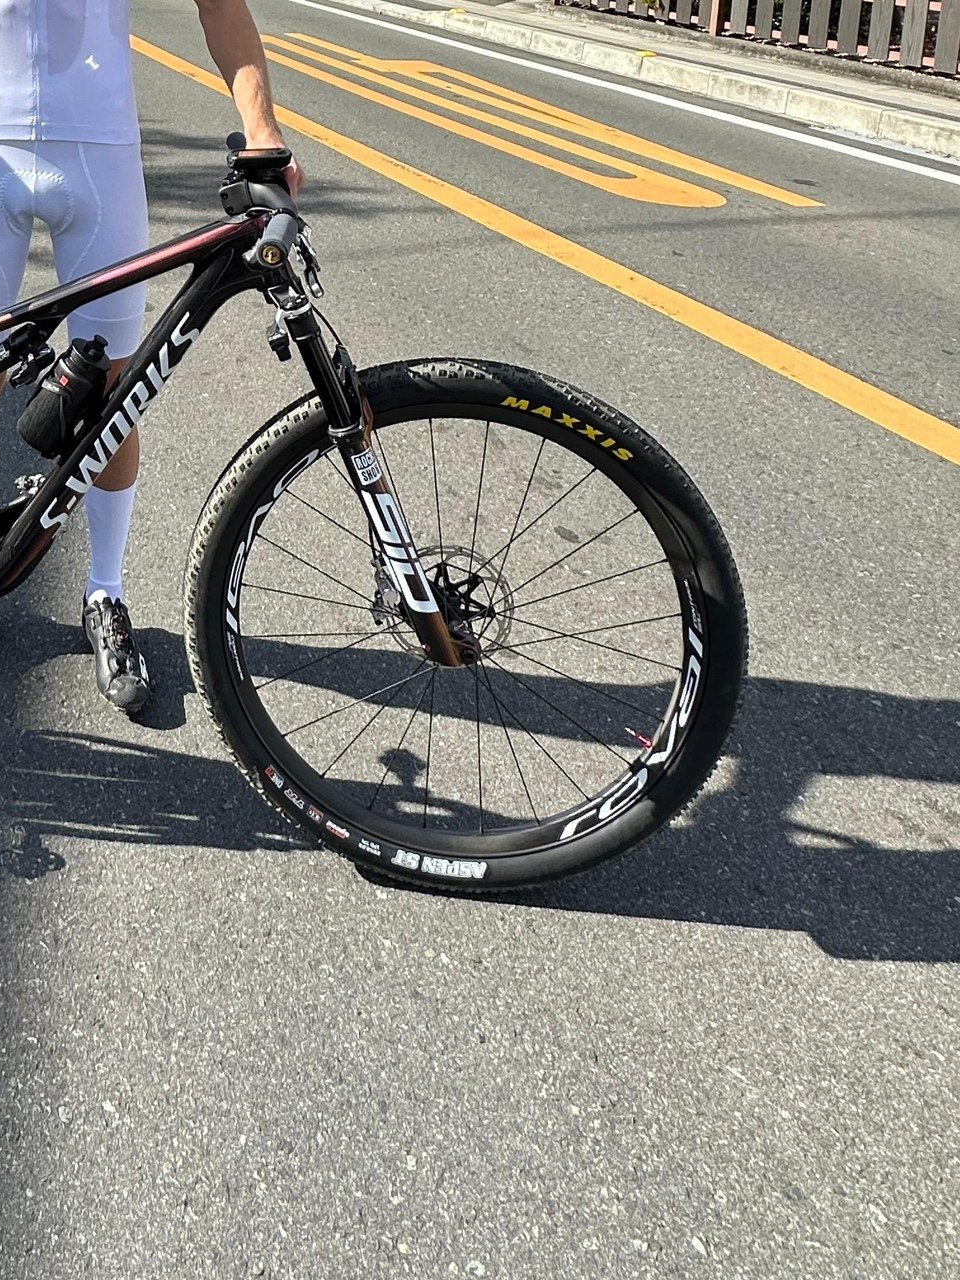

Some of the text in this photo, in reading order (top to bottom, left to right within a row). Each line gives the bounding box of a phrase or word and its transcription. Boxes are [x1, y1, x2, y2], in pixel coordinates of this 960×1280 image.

[40, 311, 200, 529] S-WORKS
[500, 396, 634, 461] MAXXIS
[360, 489, 440, 613] SID
[560, 627, 703, 840] roval
[391, 849, 421, 870] ST
[421, 856, 488, 879] ASPEN
